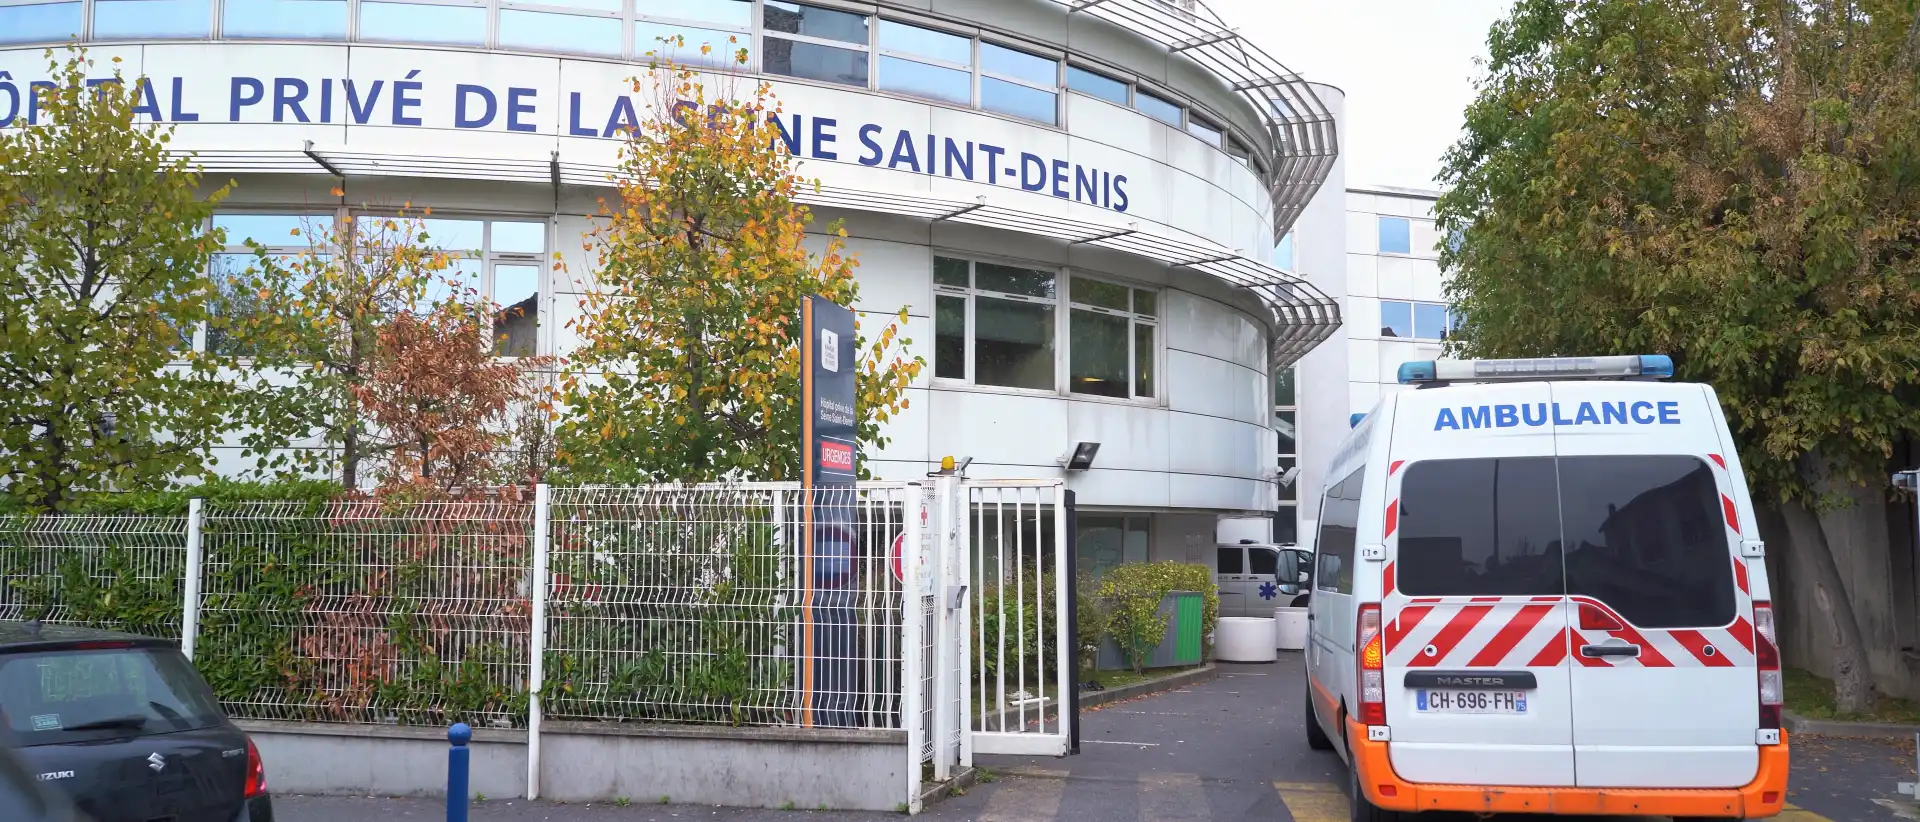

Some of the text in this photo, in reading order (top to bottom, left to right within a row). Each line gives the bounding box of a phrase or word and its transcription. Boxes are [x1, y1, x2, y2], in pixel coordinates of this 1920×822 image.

[229, 69, 423, 126] PRIVÉ
[455, 83, 537, 132] DE
[569, 92, 642, 138] LA
[858, 123, 1129, 213] SAINT-DENIS
[820, 409, 832, 422] Seine
[1434, 401, 1681, 431] AMBULANCE
[822, 447, 852, 465] URGENCES
[1437, 677, 1505, 686] MASTER
[1429, 691, 1515, 710] CH-696-FH
[1516, 702, 1526, 711] 75
[36, 770, 75, 782] UZUKI
